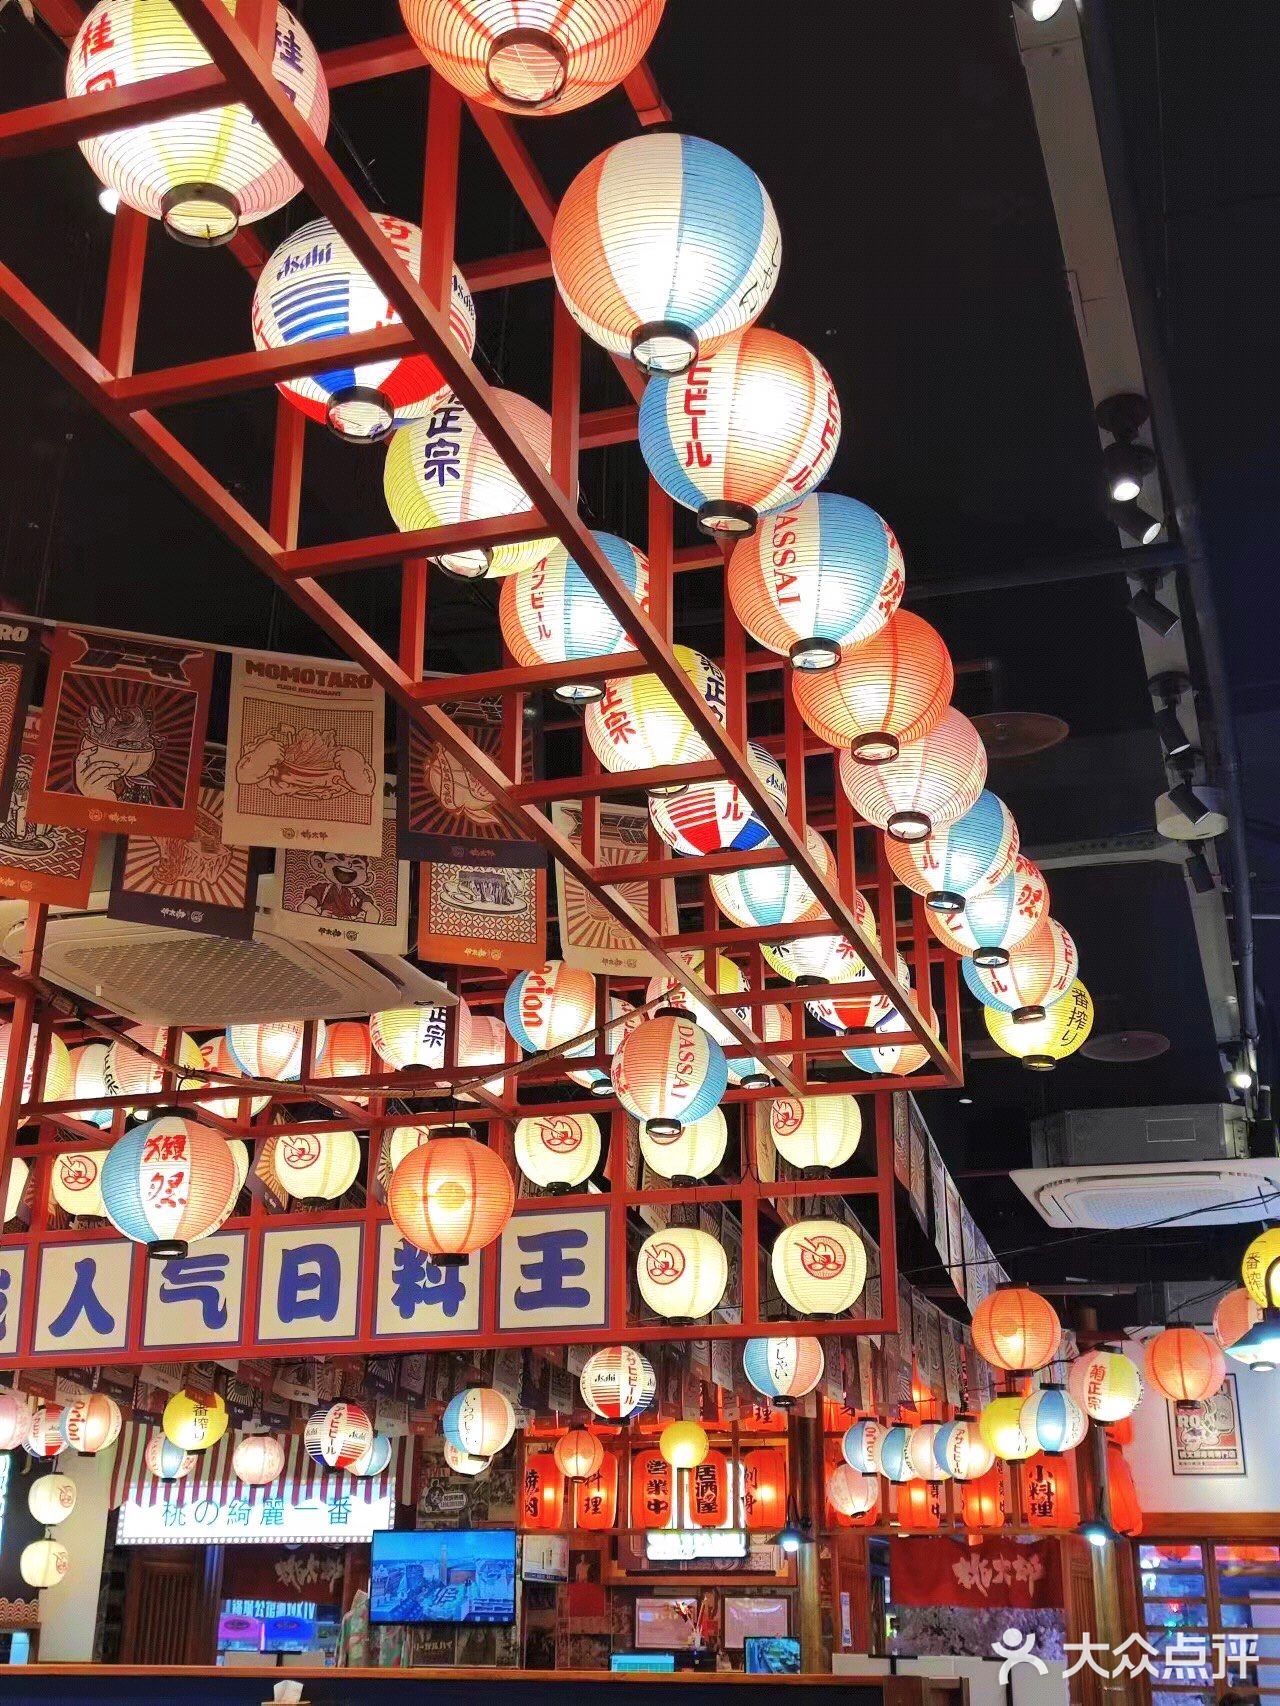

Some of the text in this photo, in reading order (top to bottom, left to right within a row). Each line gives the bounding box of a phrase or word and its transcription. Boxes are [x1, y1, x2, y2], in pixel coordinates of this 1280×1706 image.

[277, 242, 333, 281] Asahi
[684, 354, 716, 468] ヒビール
[423, 394, 465, 488] 正宗
[772, 502, 804, 607] ASSAI
[245, 660, 374, 689] MOMOTARO
[722, 780, 744, 822] ール
[670, 1023, 697, 1100] DASSAI
[594, 1373, 616, 1383] Asahi
[326, 1405, 346, 1455] アサヒビール
[161, 1495, 353, 1527] 桃の綺麗一番
[1028, 1464, 1055, 1518] 小料理
